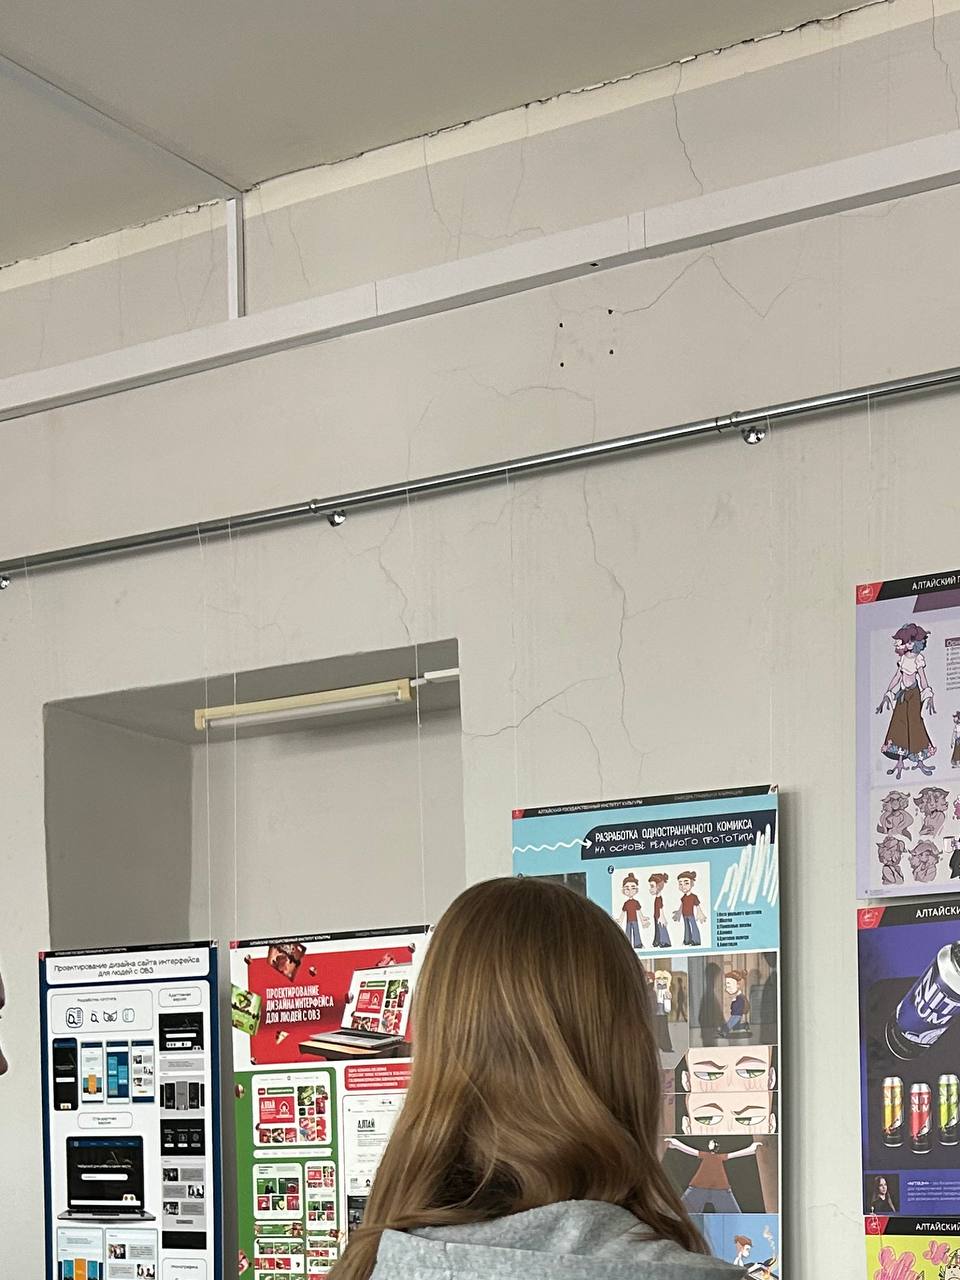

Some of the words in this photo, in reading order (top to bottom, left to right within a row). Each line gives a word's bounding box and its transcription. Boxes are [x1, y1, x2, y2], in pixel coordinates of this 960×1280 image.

[912, 575, 956, 590] АЛТАЙСКИЙ
[596, 829, 638, 842] РАЗРАБОТКА
[642, 823, 712, 838] ОДНОСТРАНИЧНОГО
[717, 819, 752, 833] КОМИКСА
[610, 842, 645, 852] ОСНОВЕ
[650, 837, 698, 849] РЕАЛЬНОГО
[703, 834, 754, 844] ПРОТОТИПА
[266, 985, 319, 999] ПРОЕКТИРОВАНИЕ
[266, 998, 294, 1011] ДИЗАЙНА
[294, 994, 334, 1009] ИНТЕРФЕЙСА
[915, 988, 952, 1025] RUM
[266, 1012, 279, 1024] ДЛЯ
[280, 1010, 301, 1023] ЛЮДЕЙ
[303, 1011, 307, 1021] С
[308, 1010, 320, 1021] ОВЗ
[911, 1094, 928, 1104] NIT
[912, 1103, 929, 1112] RUM
[358, 1118, 375, 1128] АЛТАЙ
